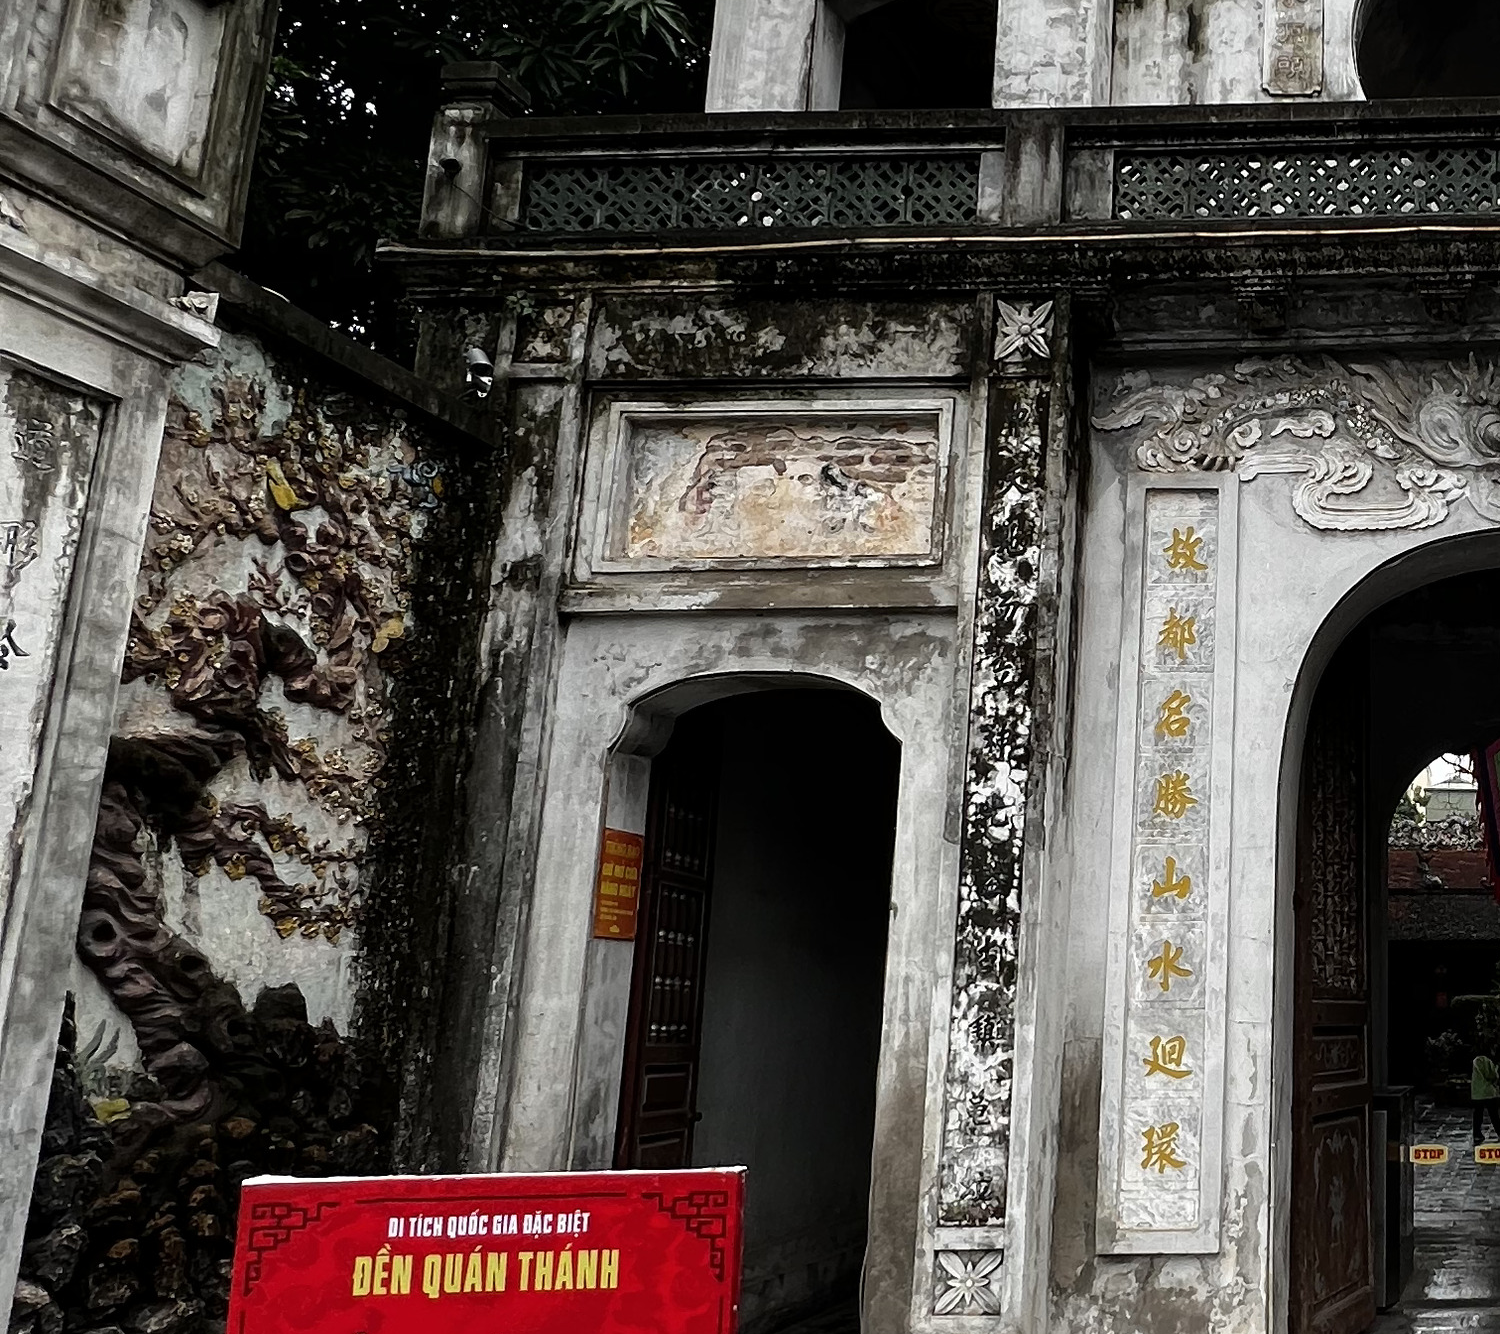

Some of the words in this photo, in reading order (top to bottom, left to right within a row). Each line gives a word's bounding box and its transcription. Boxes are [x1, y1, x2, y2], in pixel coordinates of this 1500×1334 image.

[1414, 1148, 1444, 1160] STOP
[388, 1217, 404, 1238] DI
[409, 1214, 443, 1238] TÍCH
[447, 1208, 488, 1239] QUỐC
[492, 1214, 518, 1236] GIA
[557, 1209, 591, 1238] BIỆT
[352, 1242, 414, 1296] ĐỀN
[422, 1245, 508, 1299] QUÁN
[518, 1242, 620, 1291] THÁNH
